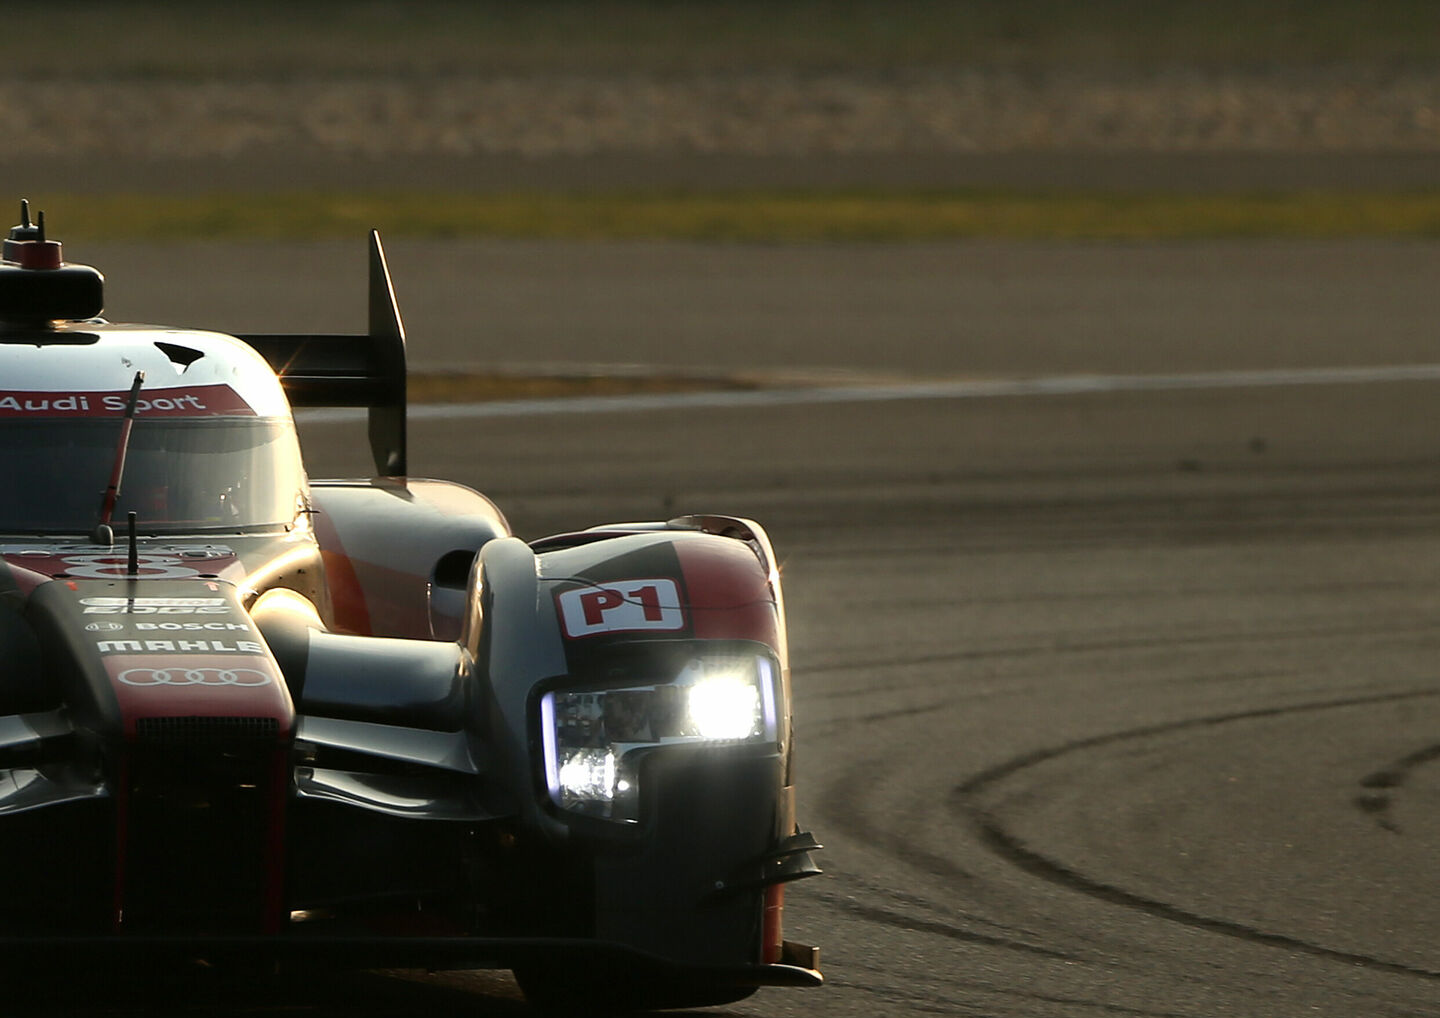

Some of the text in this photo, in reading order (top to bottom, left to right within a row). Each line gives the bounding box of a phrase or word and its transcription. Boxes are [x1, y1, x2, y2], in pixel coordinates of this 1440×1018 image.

[103, 393, 206, 414] Sport
[60, 553, 200, 579] 8
[579, 585, 664, 626] P1
[136, 622, 249, 632] BOSCH
[96, 640, 264, 653] MAHLE
